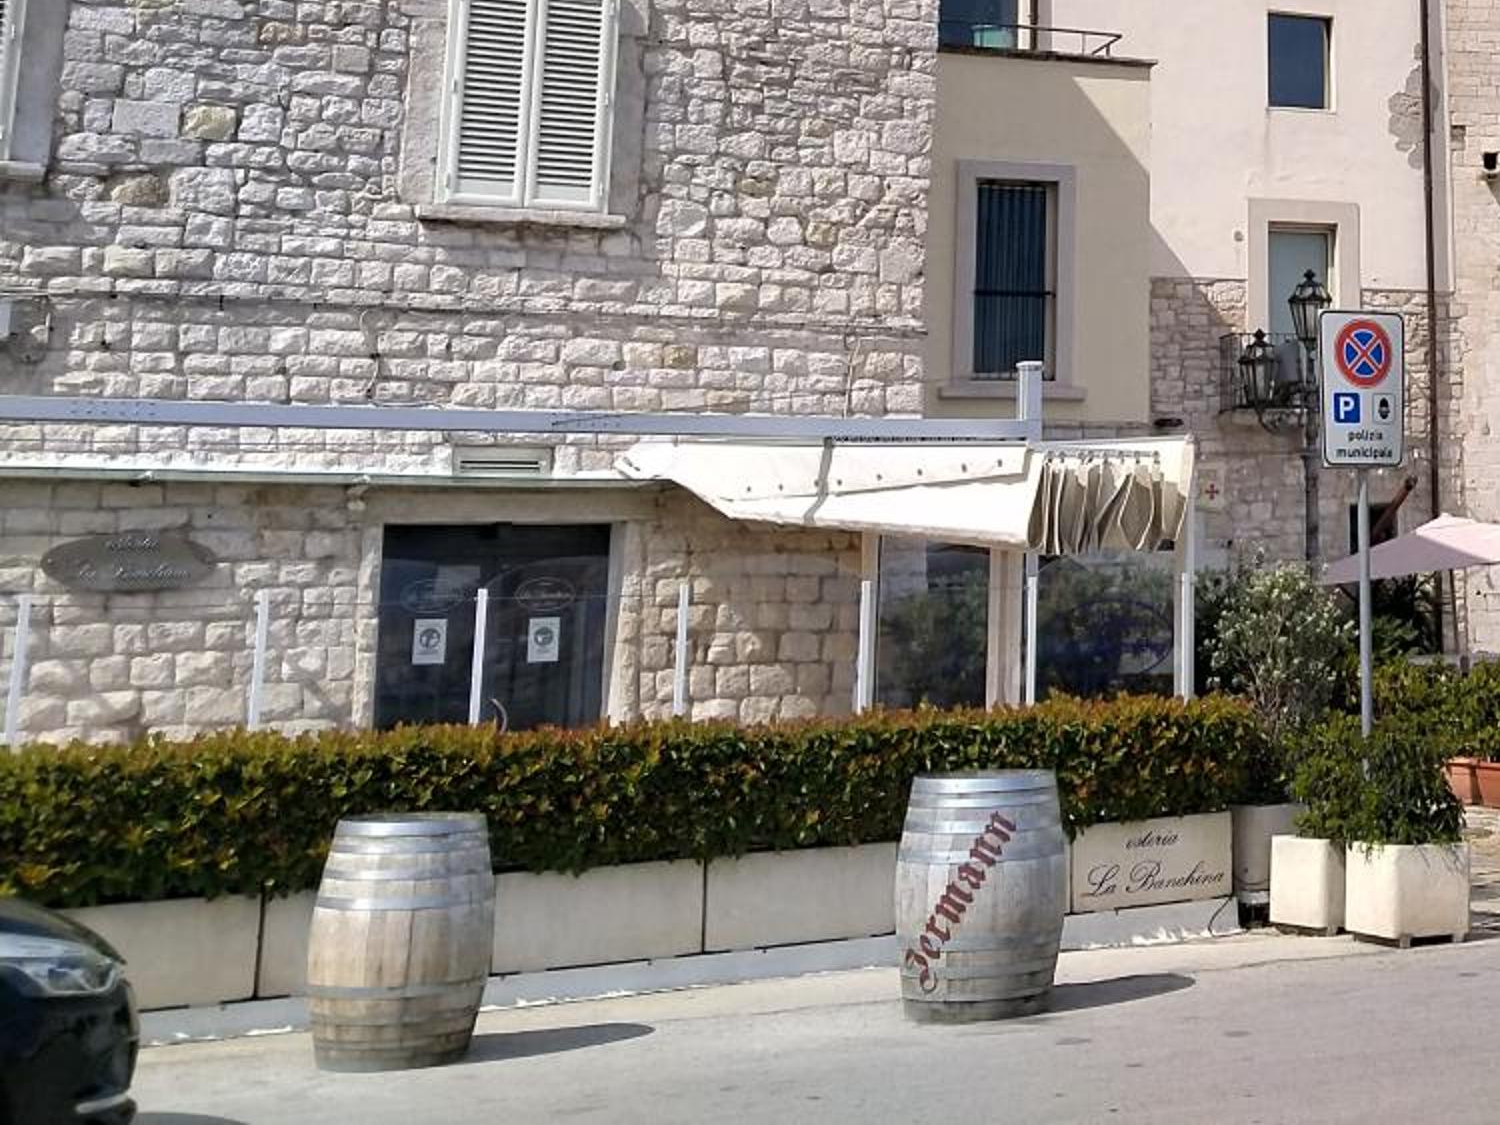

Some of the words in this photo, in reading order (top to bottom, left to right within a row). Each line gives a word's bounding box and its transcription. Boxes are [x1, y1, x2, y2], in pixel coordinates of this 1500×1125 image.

[1339, 395, 1355, 420] P
[1347, 429, 1383, 442] polizia
[1336, 446, 1393, 459] municipale
[1125, 830, 1179, 849] osteria
[1083, 863, 1120, 897] La
[1125, 860, 1225, 894] Banchina
